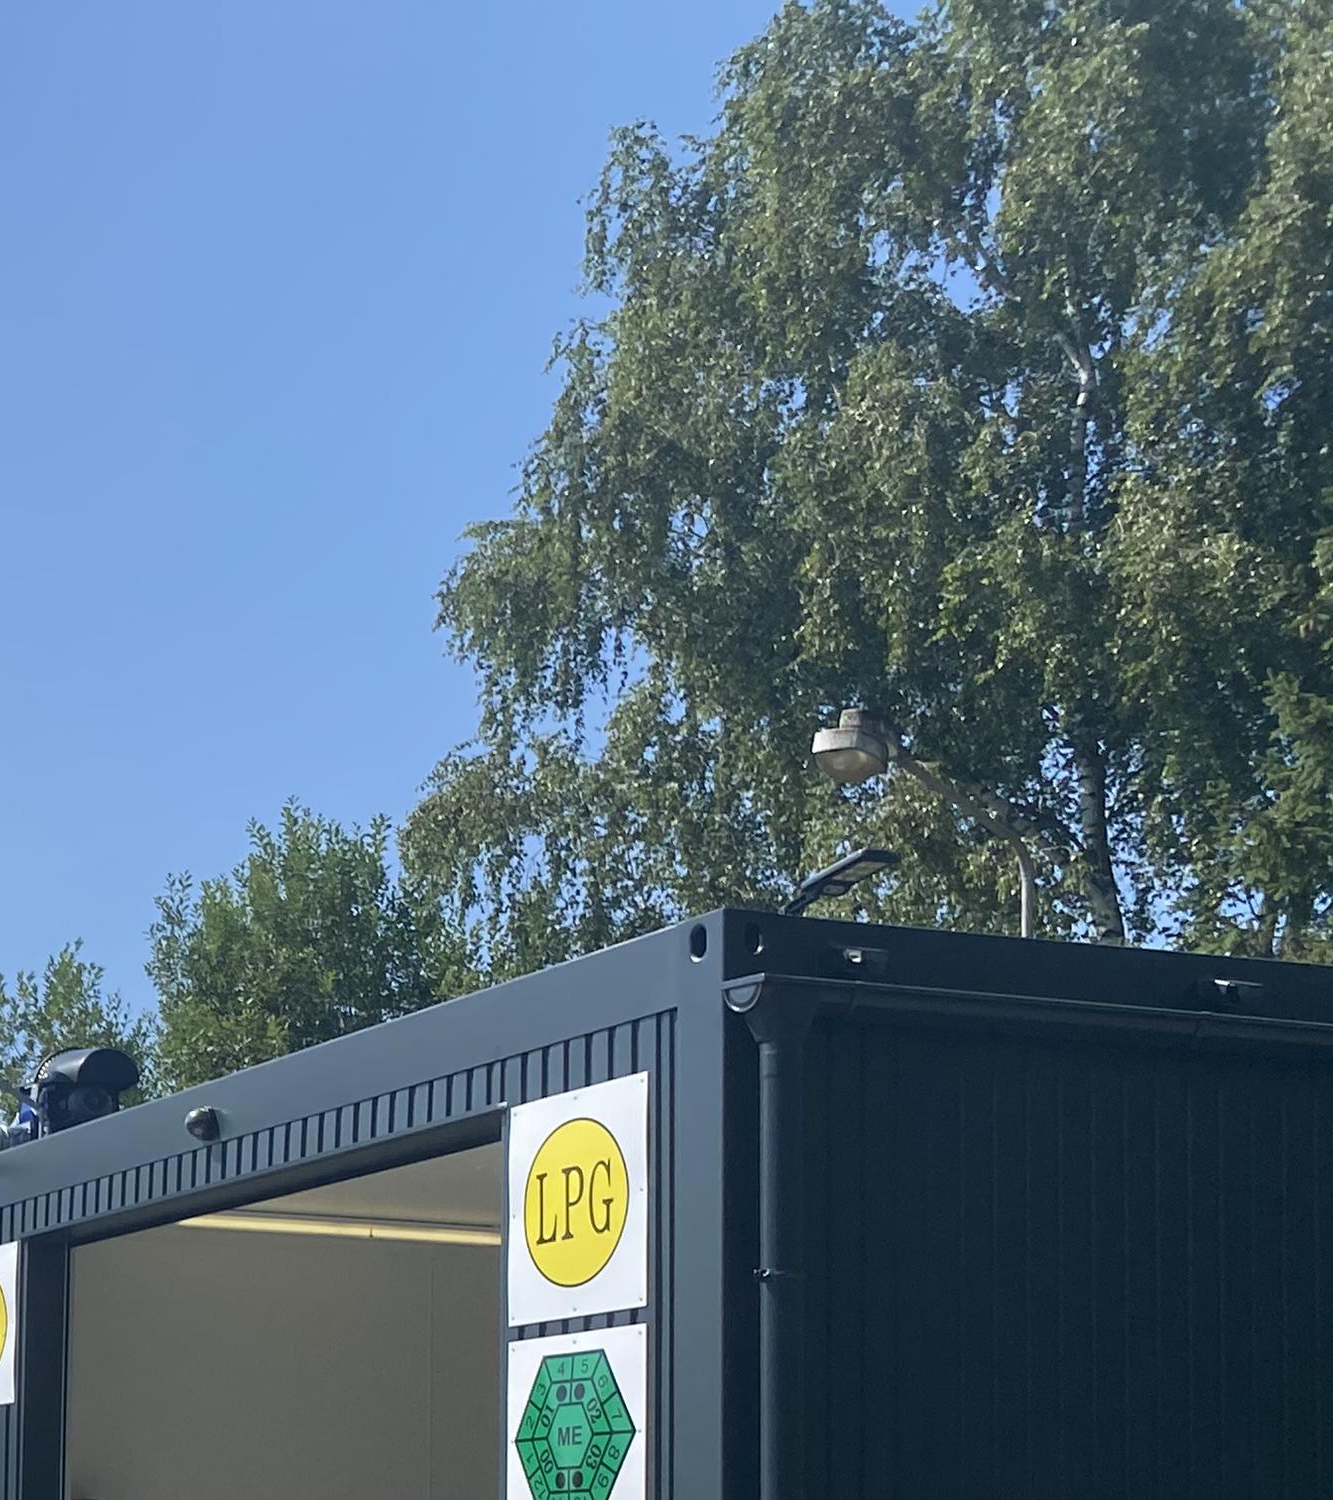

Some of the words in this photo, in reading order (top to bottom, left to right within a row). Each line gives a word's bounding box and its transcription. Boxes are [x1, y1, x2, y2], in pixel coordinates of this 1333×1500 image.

[536, 1157, 613, 1246] LPG
[557, 1361, 565, 1376] 4
[580, 1358, 589, 1374] 5
[598, 1374, 609, 1388] 6
[537, 1383, 547, 1396] 3
[540, 1404, 554, 1428] 01
[586, 1397, 602, 1424] 02
[611, 1408, 623, 1421] 7
[525, 1419, 534, 1431] 2
[557, 1425, 582, 1447] ME
[525, 1453, 534, 1464] 1
[586, 1444, 602, 1470] 03
[608, 1444, 620, 1460] 8
[540, 1450, 554, 1474] 00
[534, 1478, 546, 1500] 12
